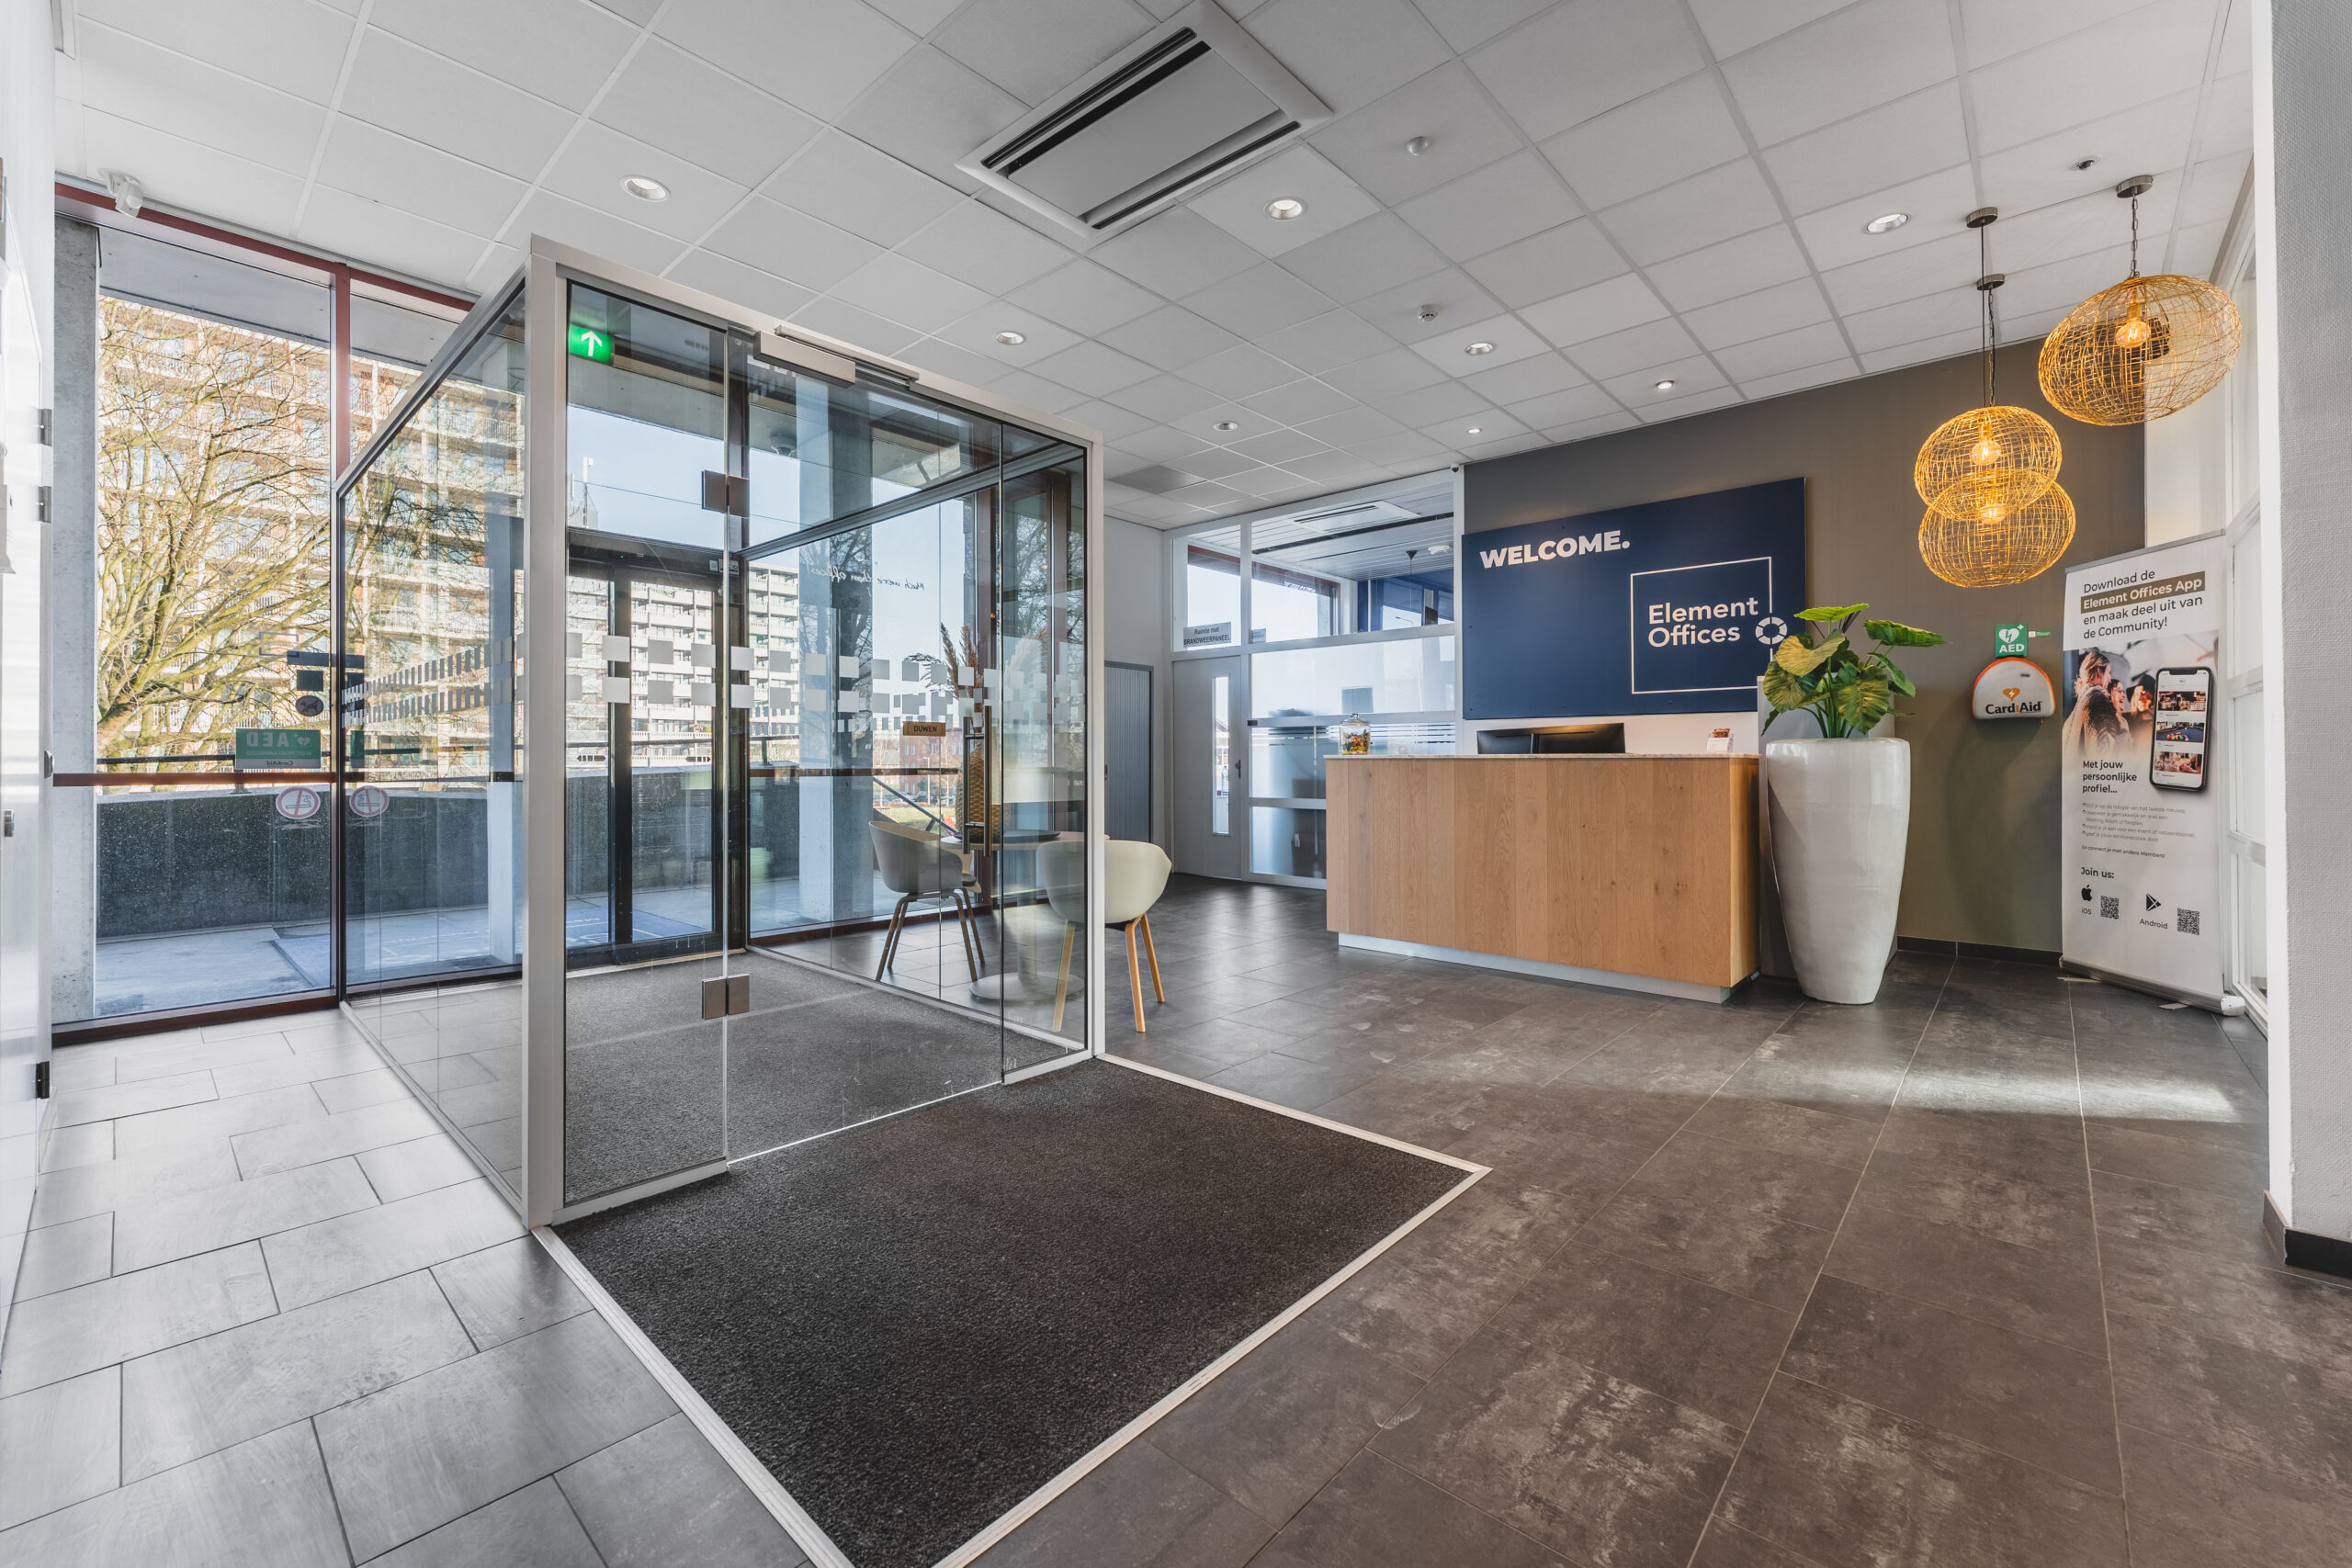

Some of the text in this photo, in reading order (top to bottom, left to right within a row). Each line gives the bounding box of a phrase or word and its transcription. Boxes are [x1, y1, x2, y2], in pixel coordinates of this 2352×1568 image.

[1479, 529, 1631, 569] WELCOME.
[2084, 570, 2155, 593] Download de
[2083, 578, 2202, 610] Element Offices App
[1648, 597, 1758, 625] Element
[2083, 596, 2203, 626] en maak deel uit van
[1647, 623, 1741, 648] Offices
[2083, 617, 2168, 640] de Community!
[1998, 643, 2025, 653] AED
[2083, 760, 2123, 771] Met jouw
[2083, 772, 2138, 784] persoonlijke
[2082, 784, 2118, 795] profiel...
[2081, 866, 2115, 880] Join us:
[2081, 907, 2092, 916] iOS
[2139, 918, 2168, 930] Android
